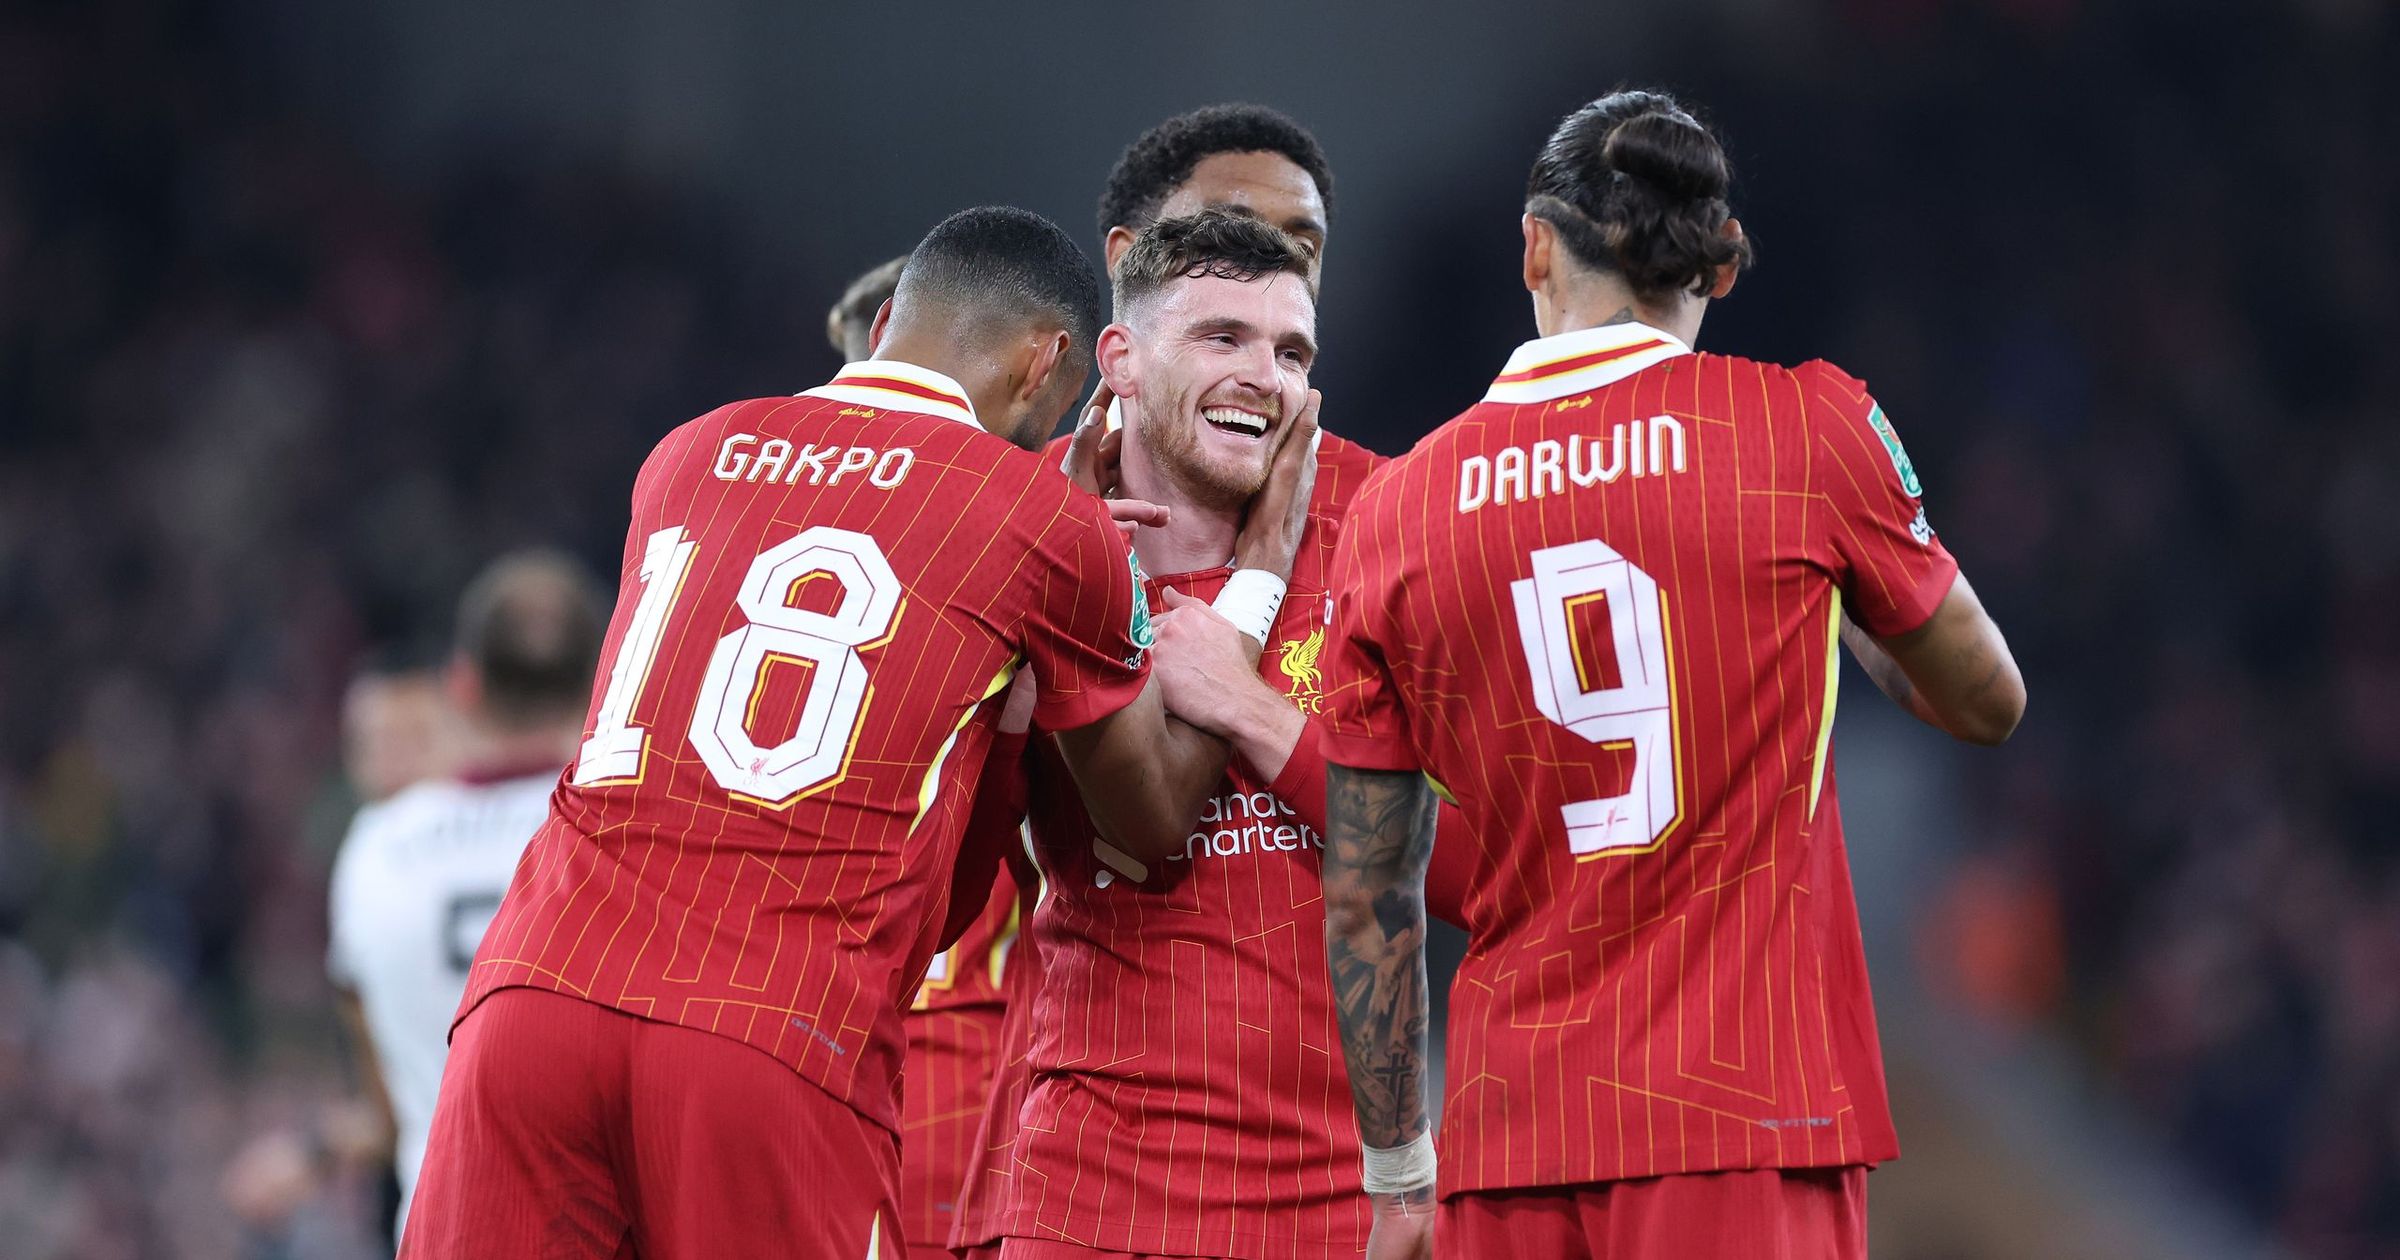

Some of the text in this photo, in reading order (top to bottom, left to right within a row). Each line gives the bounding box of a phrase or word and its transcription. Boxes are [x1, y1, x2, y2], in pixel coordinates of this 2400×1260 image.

[713, 433, 915, 489] GAKPO
[1458, 415, 1687, 514] DARWIN
[573, 525, 907, 811] 18
[1298, 695, 1324, 714] FC
[1510, 538, 1685, 863] 9
